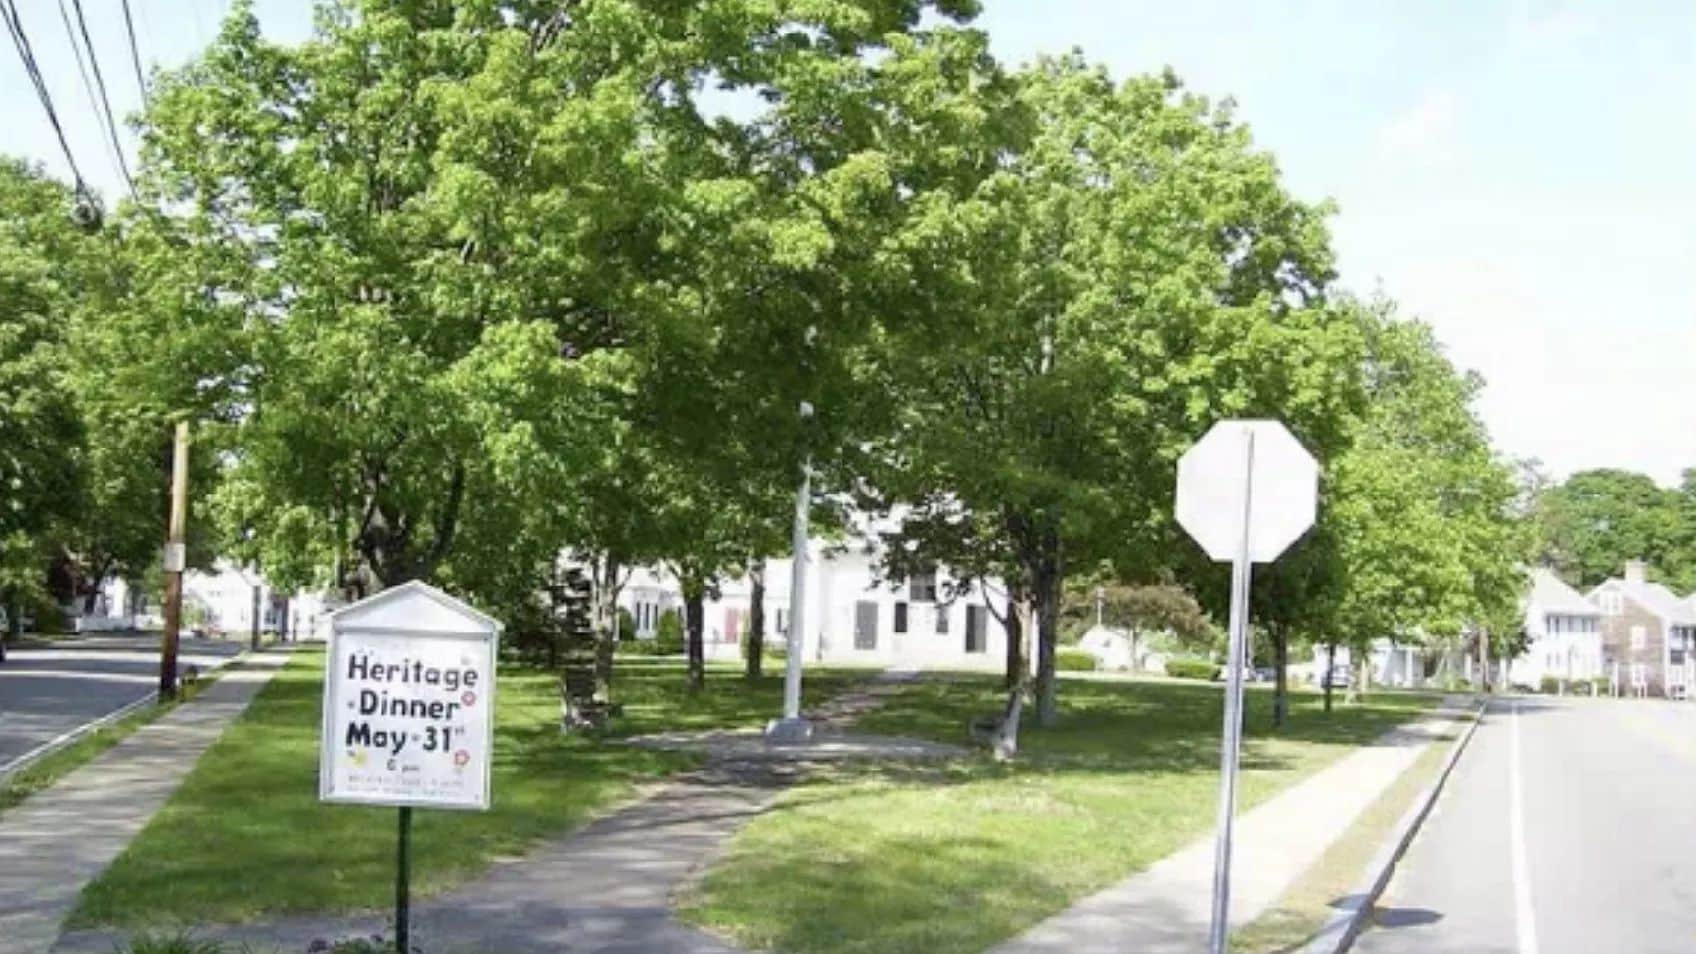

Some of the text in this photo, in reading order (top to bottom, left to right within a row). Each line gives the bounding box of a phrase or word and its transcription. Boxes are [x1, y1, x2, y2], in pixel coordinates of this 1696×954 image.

[348, 654, 478, 691] Heritage
[359, 689, 461, 720] Dinner
[346, 721, 406, 755] May
